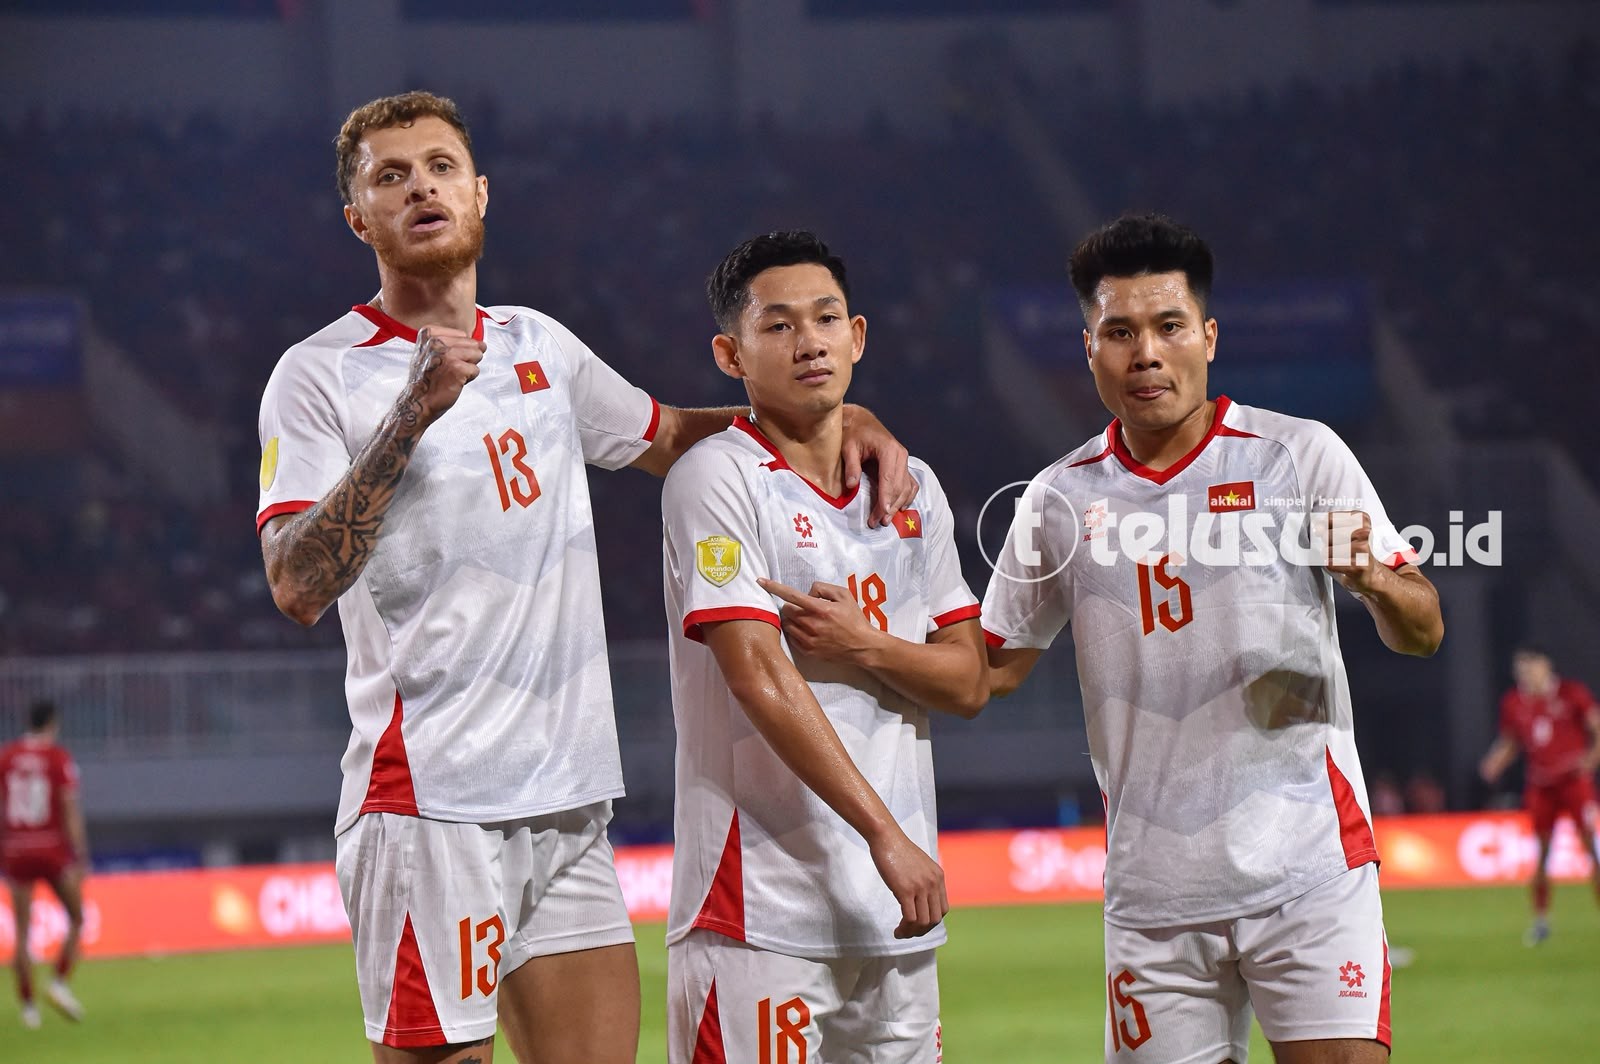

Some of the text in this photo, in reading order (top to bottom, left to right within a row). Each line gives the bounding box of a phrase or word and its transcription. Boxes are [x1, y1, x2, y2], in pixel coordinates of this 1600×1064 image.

[483, 428, 542, 512] 13
[1136, 551, 1194, 636] 15
[459, 913, 505, 1000] 13
[757, 996, 811, 1064] 18
[1108, 969, 1153, 1053] 15
